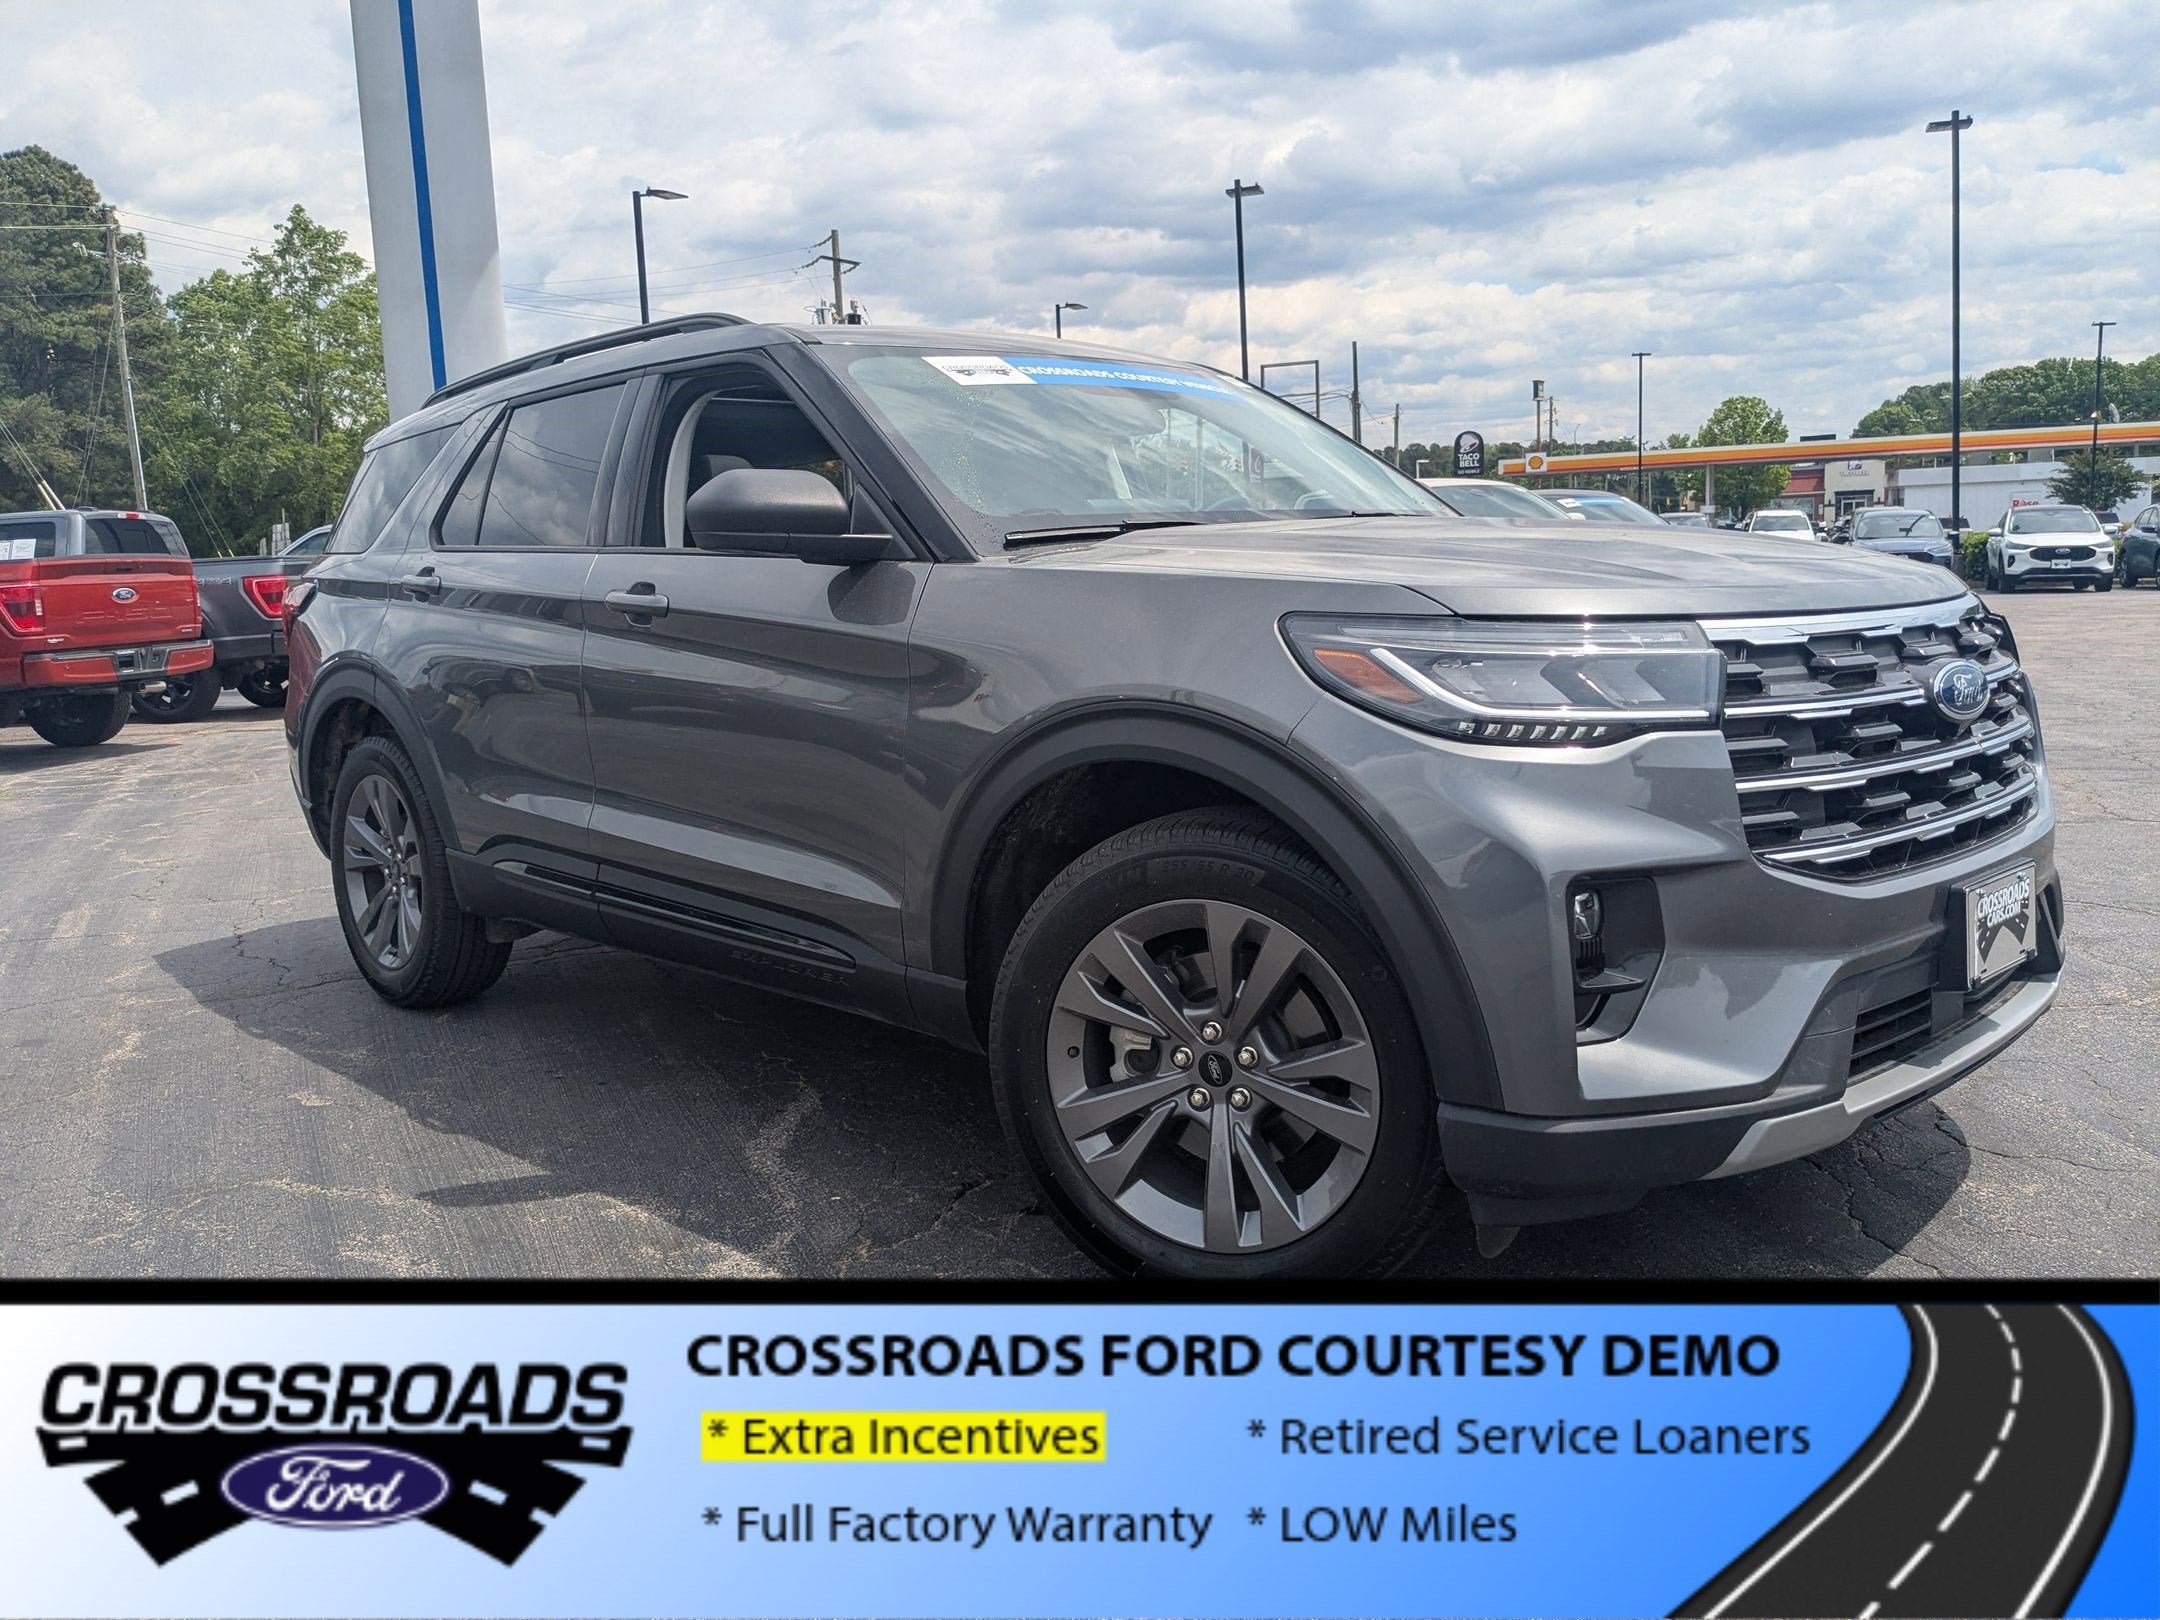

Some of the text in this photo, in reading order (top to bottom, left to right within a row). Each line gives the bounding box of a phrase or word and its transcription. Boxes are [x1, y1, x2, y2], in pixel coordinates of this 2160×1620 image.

[1017, 366, 1115, 378] CROSSROADS
[1114, 371, 1182, 386] COURTESY
[1457, 453, 1480, 461] TACO
[1459, 460, 1480, 468] BELL
[1951, 673, 1984, 706] Ford
[1977, 878, 2031, 918] CROSSROADS
[1986, 900, 2022, 928] CARS.COM
